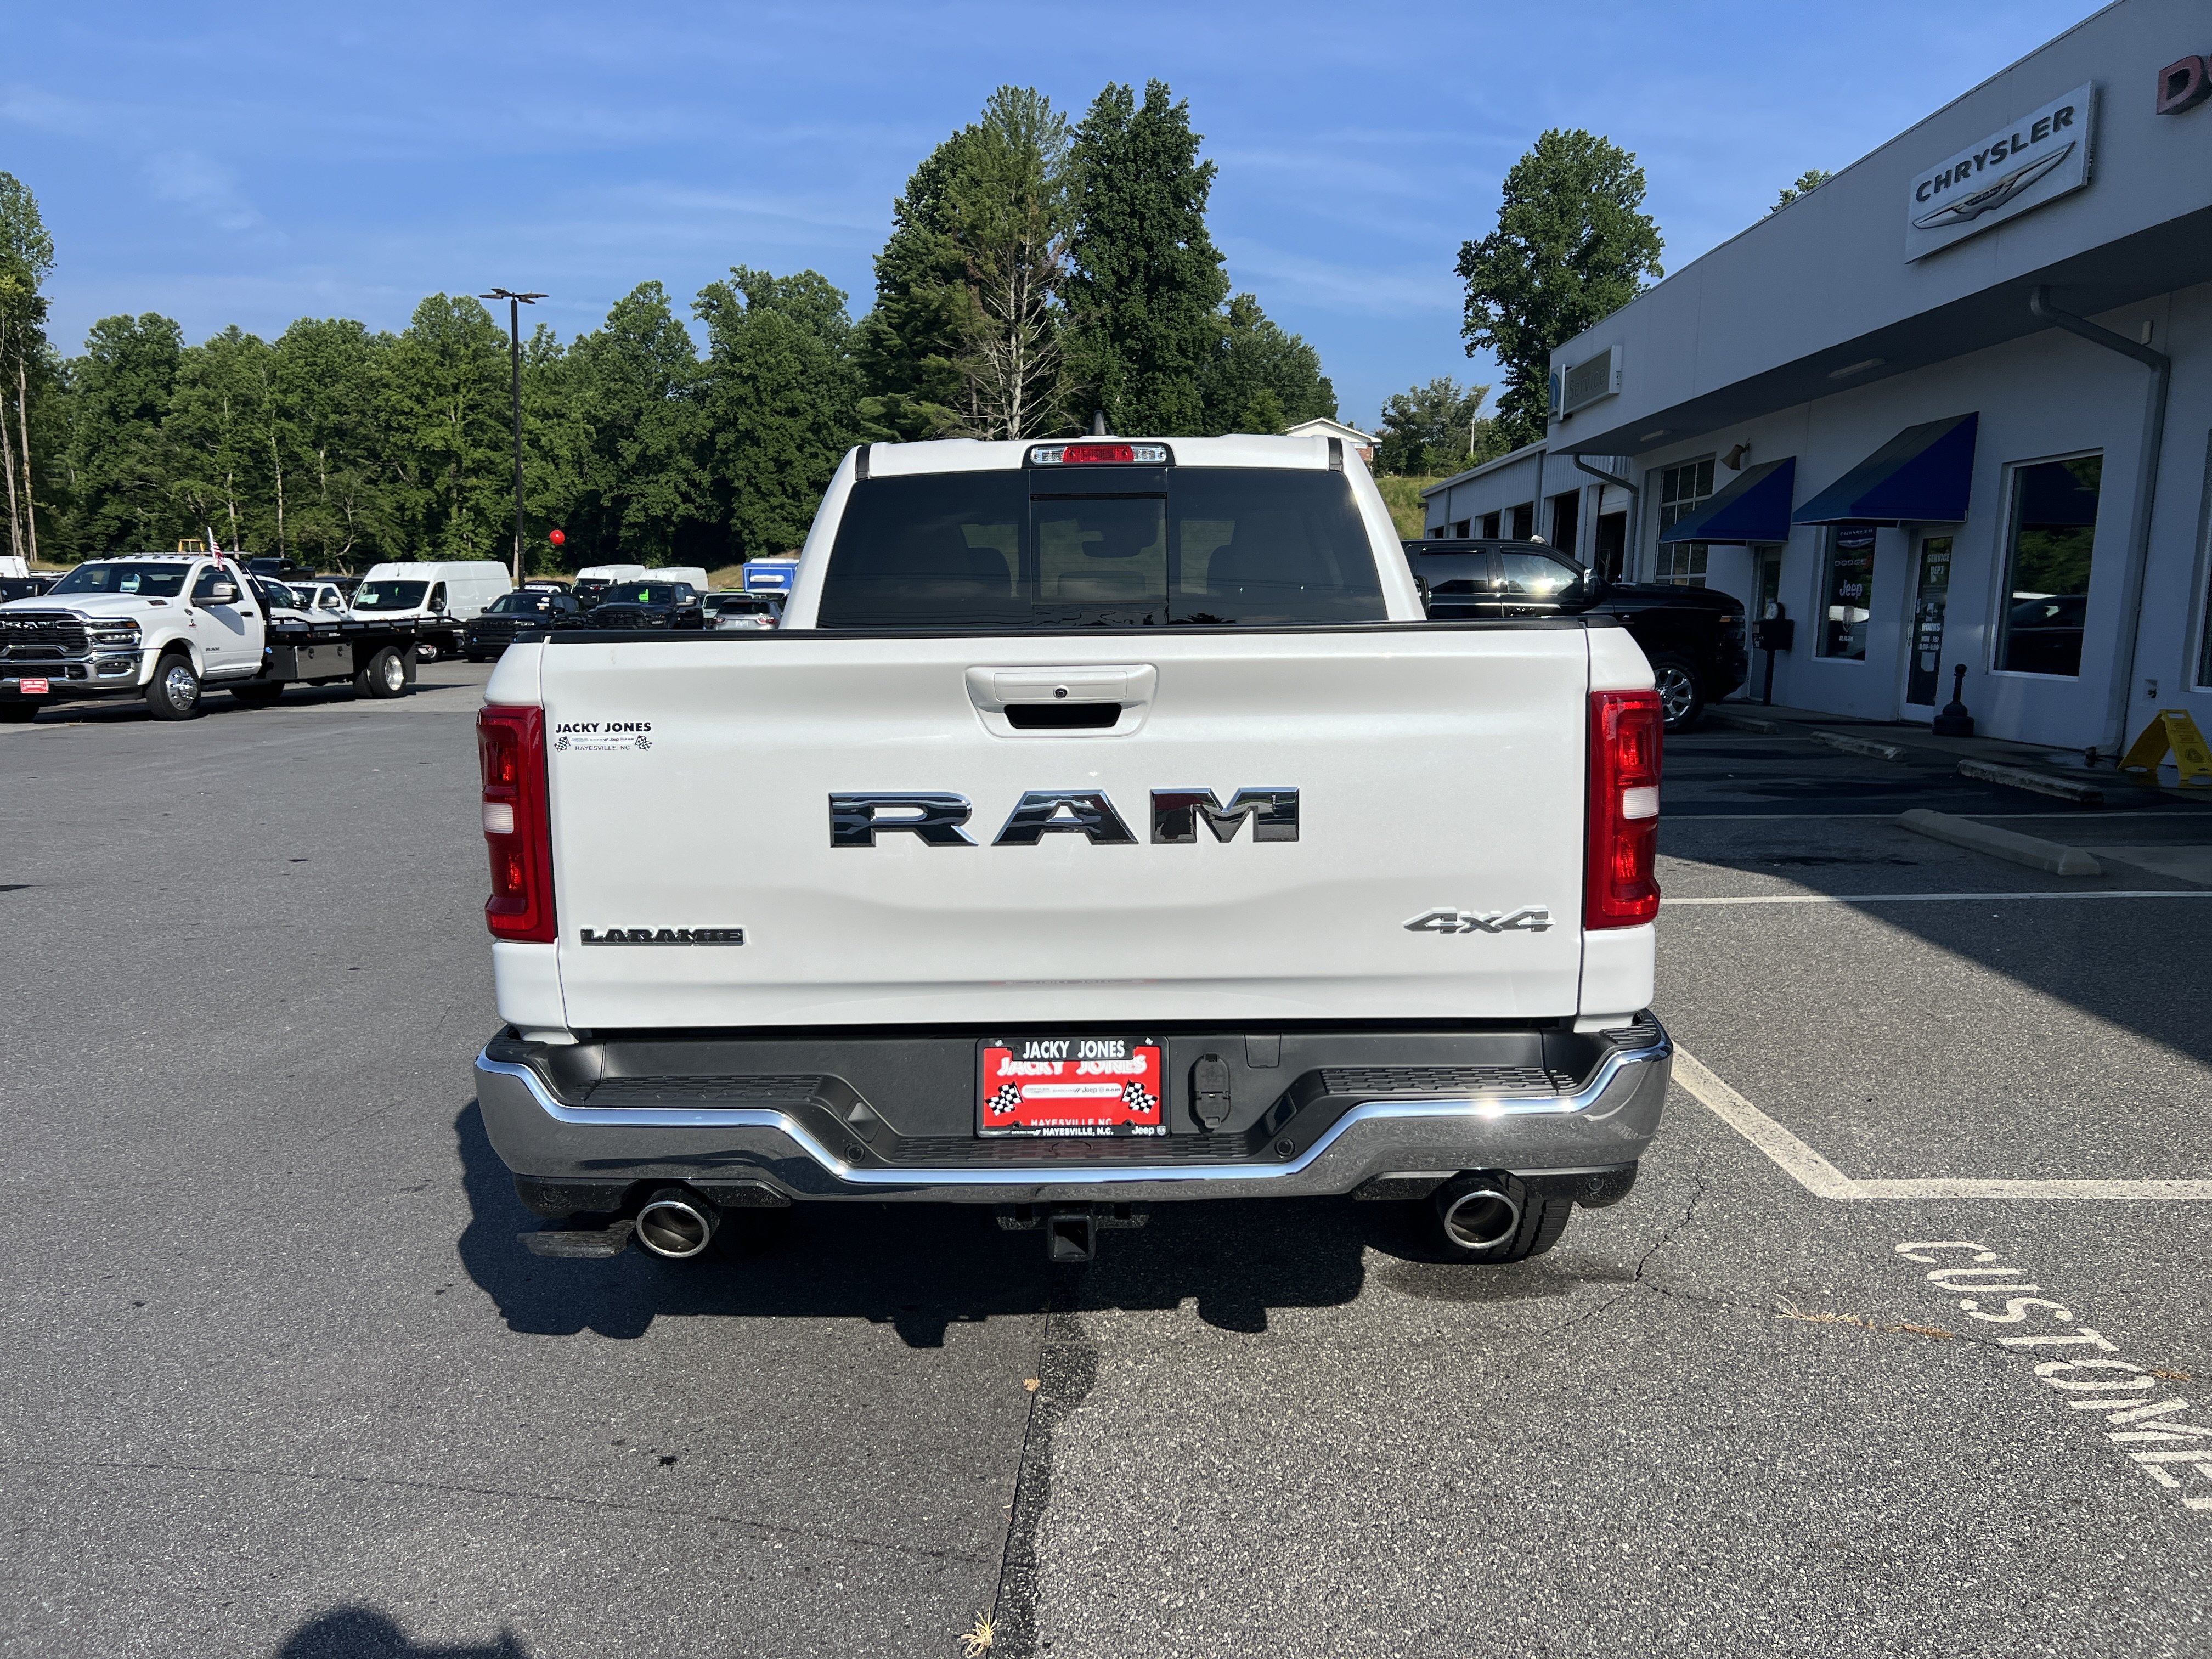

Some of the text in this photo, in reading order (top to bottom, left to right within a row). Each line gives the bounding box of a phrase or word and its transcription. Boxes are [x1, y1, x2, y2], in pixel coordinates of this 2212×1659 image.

[1915, 106, 2075, 203] CHRYSLER
[1568, 368, 1607, 400] Service
[1835, 558, 1867, 567] DODGE
[1927, 552, 1950, 563] SERVICE
[1930, 566, 1945, 575] DEPT
[1839, 579, 1863, 601] Jeep
[1922, 623, 1941, 632] HOURS
[555, 721, 652, 733] JACKY JONES
[828, 786, 1300, 848] RAM
[580, 927, 745, 946] LARAMIE
[1023, 1040, 1125, 1059] JACKY JONES
[997, 1054, 1147, 1076] JACKY JONES
[1043, 1127, 1095, 1137] HAYESVILLE,
[1096, 1127, 1114, 1136] N.C.
[1131, 1125, 1155, 1136] Jeep
[1894, 1240, 2212, 1510] CUSTOME
